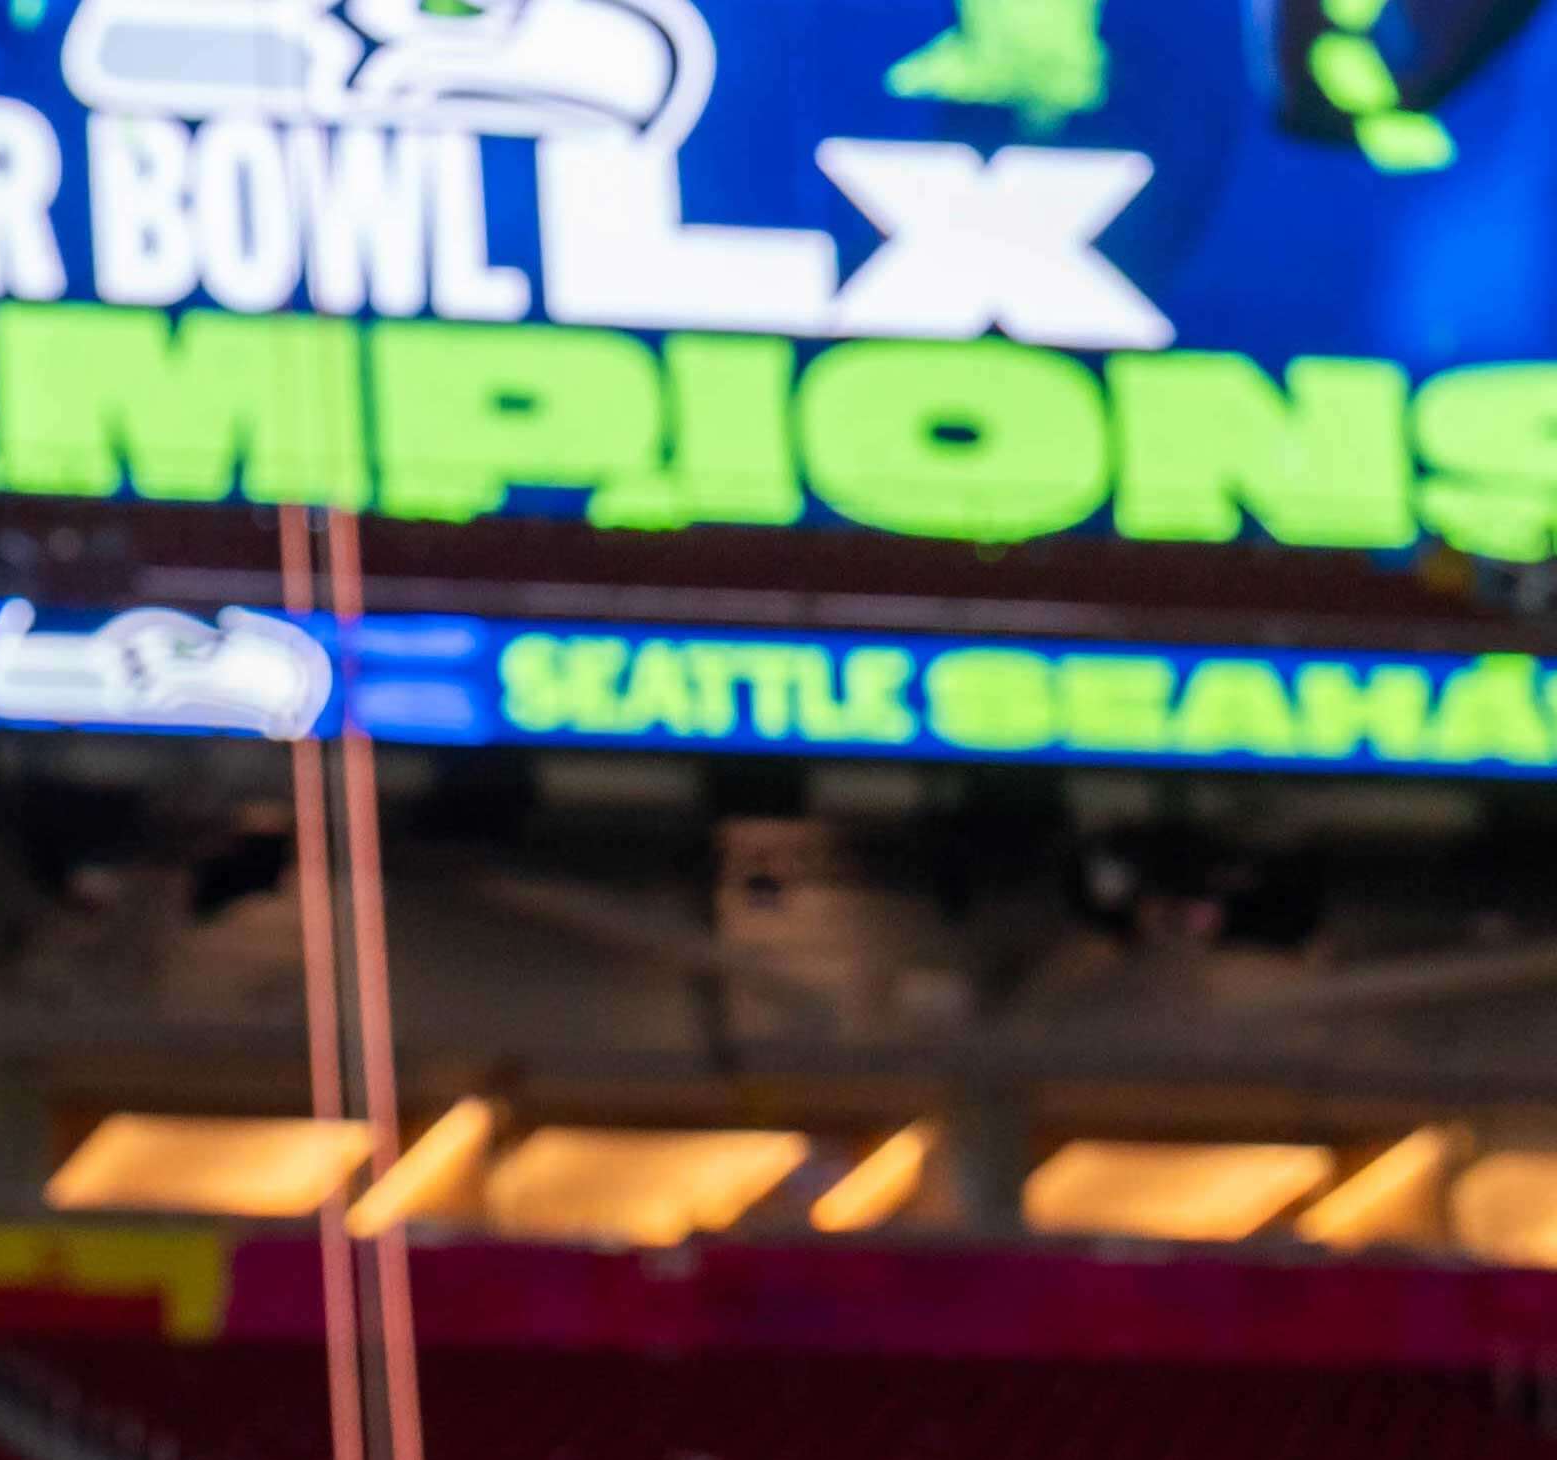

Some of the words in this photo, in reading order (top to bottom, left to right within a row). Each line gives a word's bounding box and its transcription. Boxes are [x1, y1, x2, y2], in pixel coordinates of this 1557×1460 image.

[87, 108, 533, 322] BOWL
[535, 130, 1177, 350] LX
[497, 632, 921, 746] SEATTLE
[921, 650, 1557, 768] SEAHA
